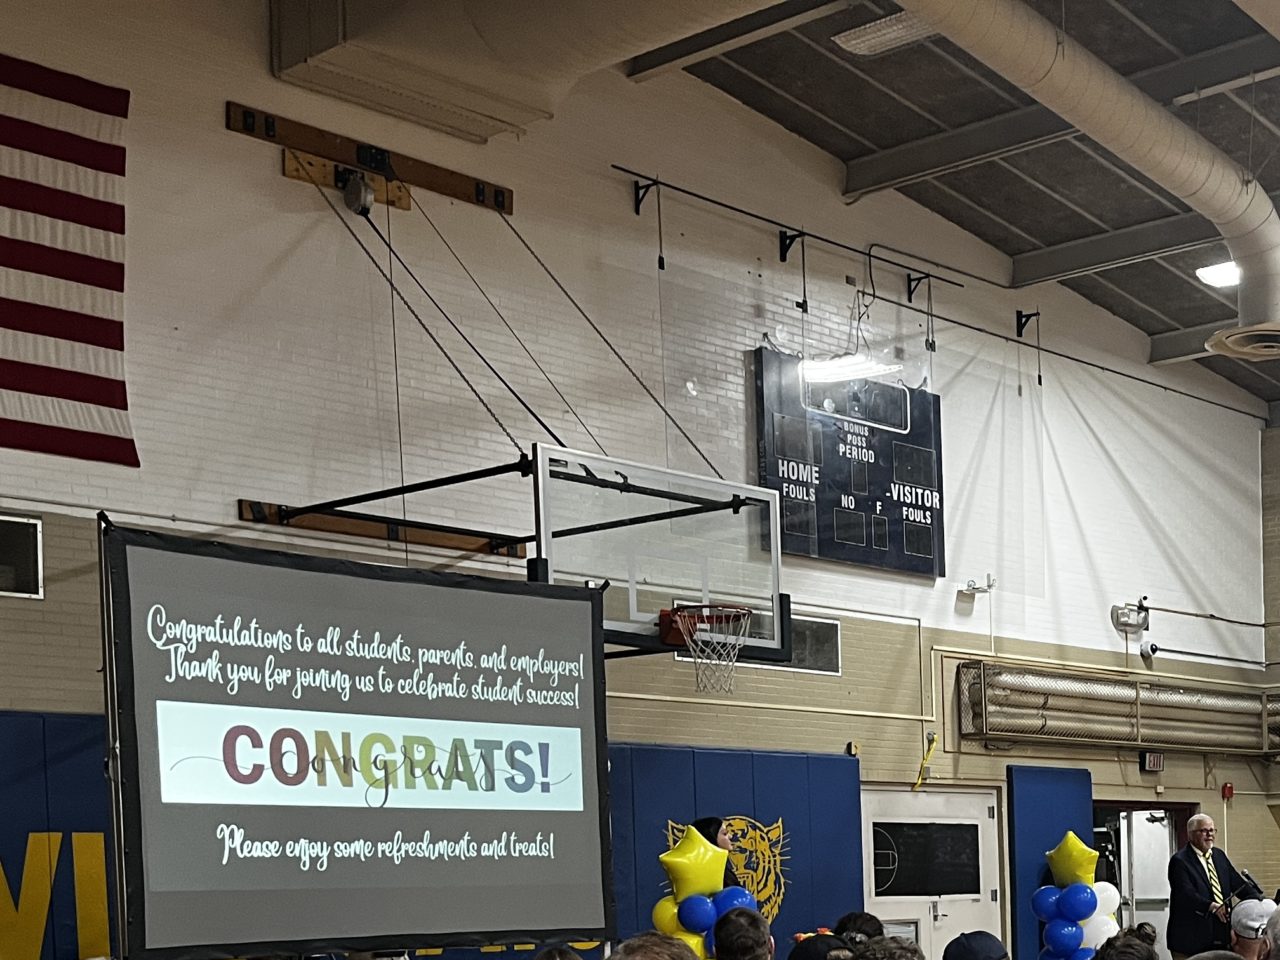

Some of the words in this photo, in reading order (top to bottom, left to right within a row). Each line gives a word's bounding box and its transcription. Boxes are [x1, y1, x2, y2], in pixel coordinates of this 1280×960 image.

[844, 421, 869, 437] BONUS
[847, 433, 867, 447] POSS
[839, 443, 875, 463] PERIOD
[778, 459, 820, 485] HOME
[782, 483, 816, 502] FOULS
[841, 494, 855, 509] NO
[876, 501, 883, 515] F
[902, 506, 932, 524] FOULS
[147, 604, 292, 653] Congratulations
[296, 623, 314, 652] to
[317, 626, 342, 655] all
[480, 644, 507, 673] and
[510, 648, 584, 687] employers!
[157, 643, 223, 684] Thank
[227, 662, 261, 695] you
[265, 655, 291, 691] for
[292, 667, 352, 701] joining
[356, 675, 375, 693] us
[378, 665, 395, 693] to
[397, 669, 469, 700] celebrate
[471, 674, 524, 706] student
[526, 683, 580, 709] success!
[222, 725, 551, 794] CONGRATS!
[216, 824, 282, 865] Please
[285, 836, 330, 871] enjoy
[334, 837, 374, 859] some
[377, 830, 478, 865] refreshments
[480, 832, 507, 859] and
[509, 832, 555, 859] treats!
